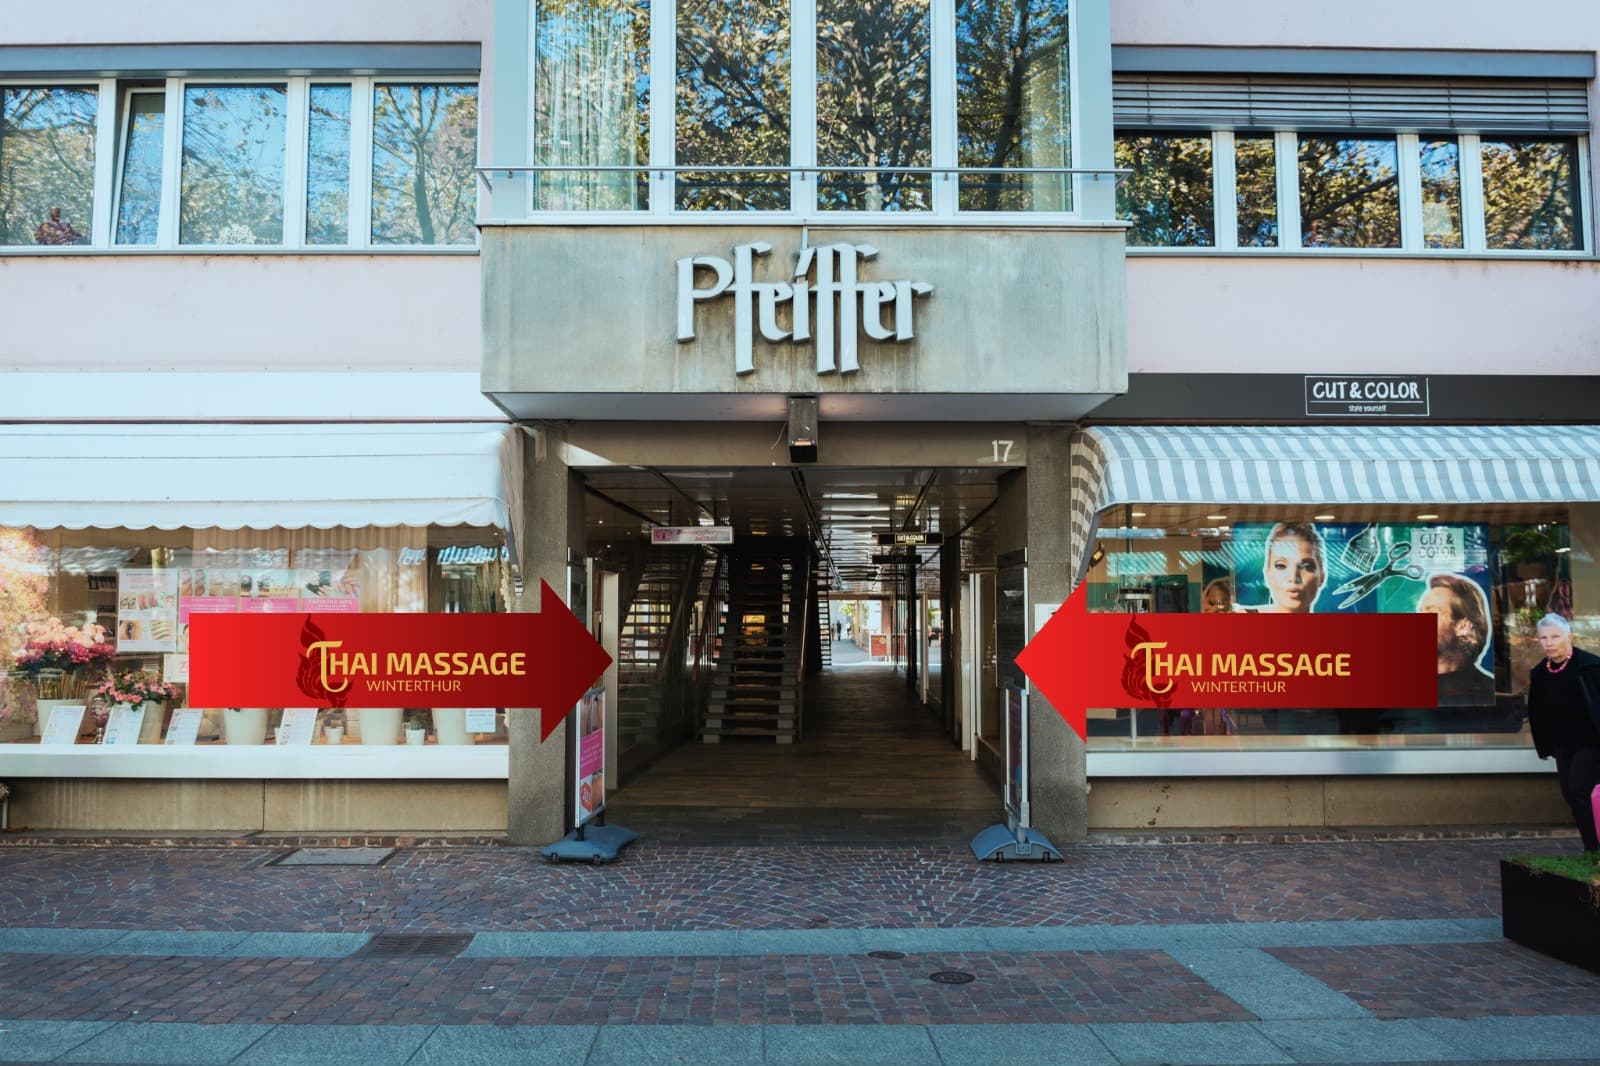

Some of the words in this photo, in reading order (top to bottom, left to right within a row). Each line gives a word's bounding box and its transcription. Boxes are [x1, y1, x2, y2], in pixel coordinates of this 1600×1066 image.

[676, 240, 935, 375] Pfeiffer
[1348, 404, 1362, 413] style
[1363, 404, 1387, 413] yourself
[991, 439, 1014, 463] 17
[1446, 533, 1455, 545] &
